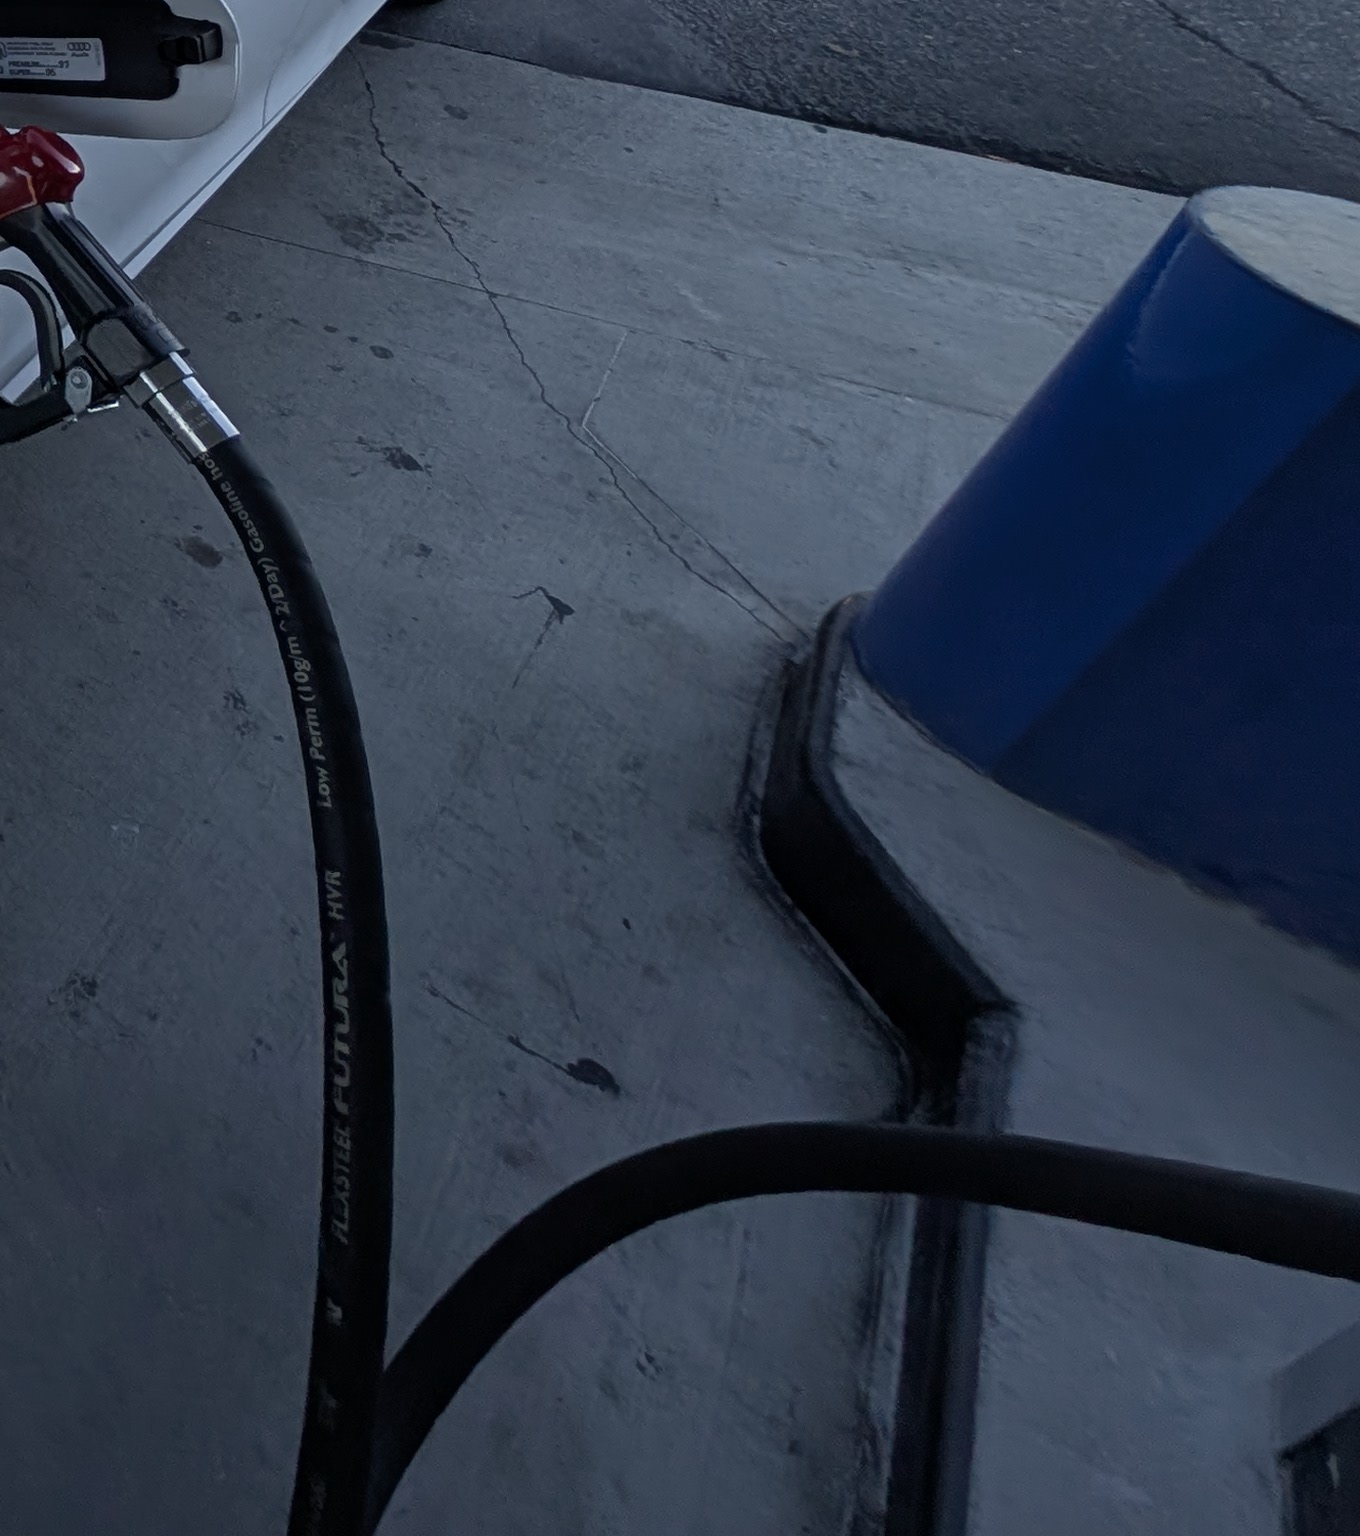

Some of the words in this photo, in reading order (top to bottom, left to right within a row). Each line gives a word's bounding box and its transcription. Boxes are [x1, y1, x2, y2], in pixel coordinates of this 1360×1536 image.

[199, 452, 223, 481] hos
[220, 481, 264, 553] Gasoline
[305, 707, 326, 762] Perm
[316, 765, 333, 808] Low
[325, 870, 345, 921] HVR
[332, 941, 351, 1115] FUTURA
